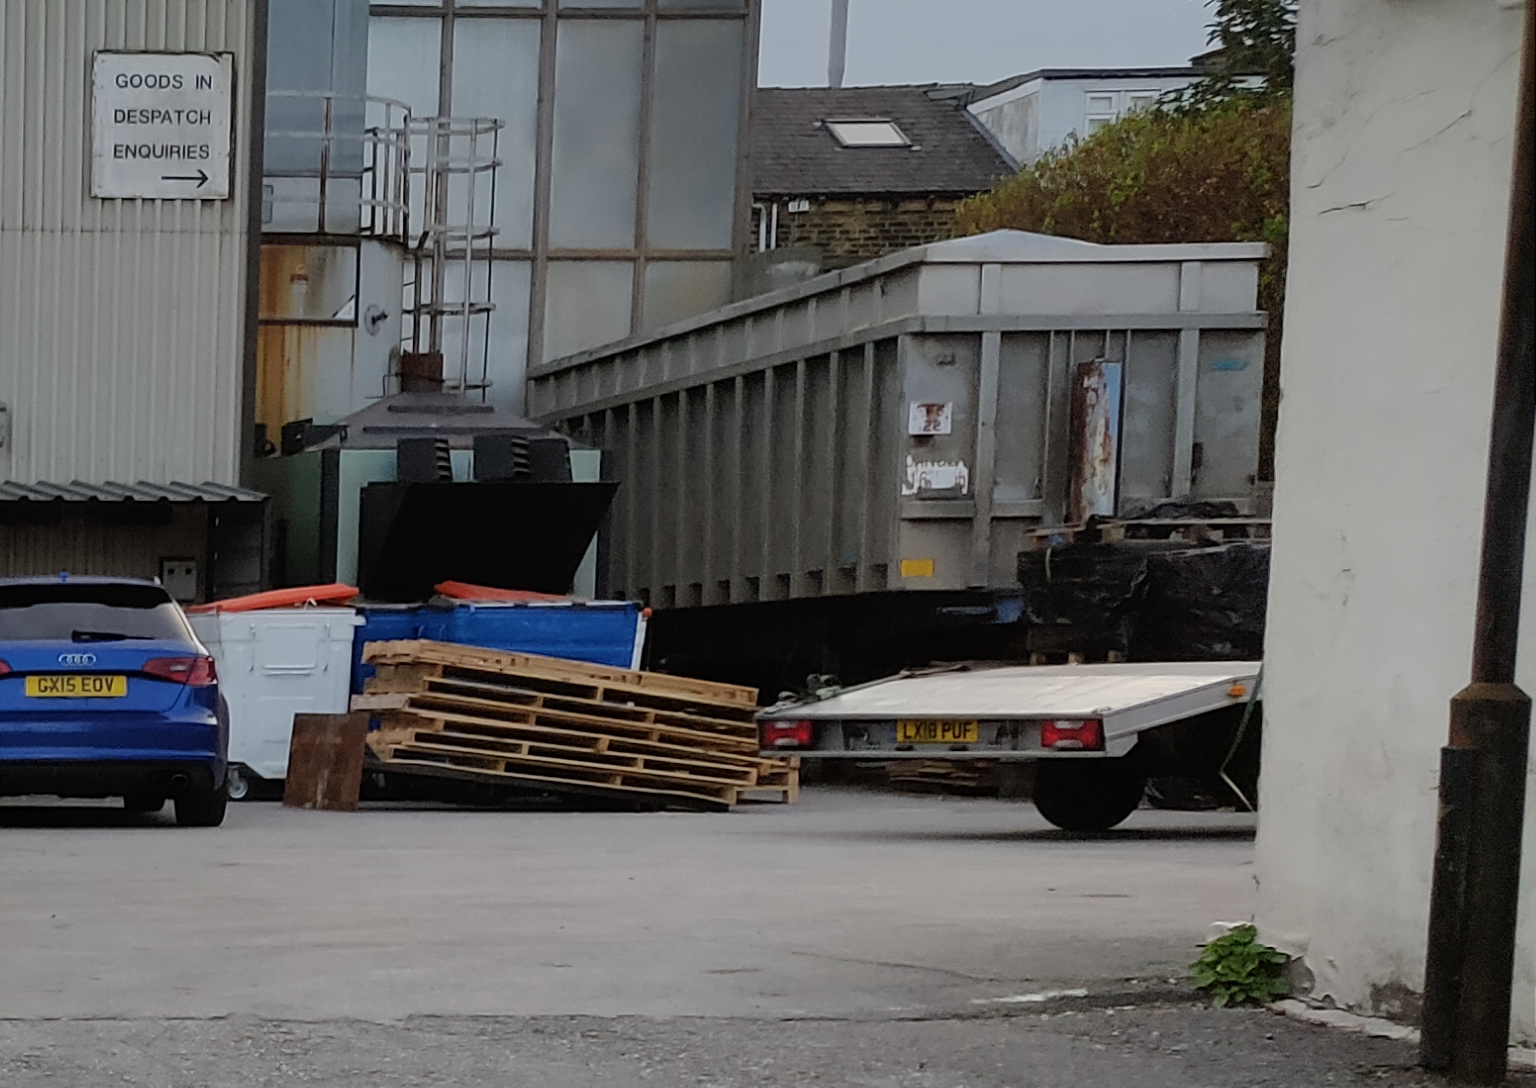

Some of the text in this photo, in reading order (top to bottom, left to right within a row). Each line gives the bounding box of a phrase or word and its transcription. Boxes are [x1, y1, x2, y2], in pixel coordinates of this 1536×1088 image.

[115, 73, 213, 90] GOODS IN
[114, 108, 211, 125] DESPATCH
[113, 144, 210, 160] ENQUIRIES
[38, 677, 115, 693] GX15 EOV
[941, 721, 973, 739] PUF
